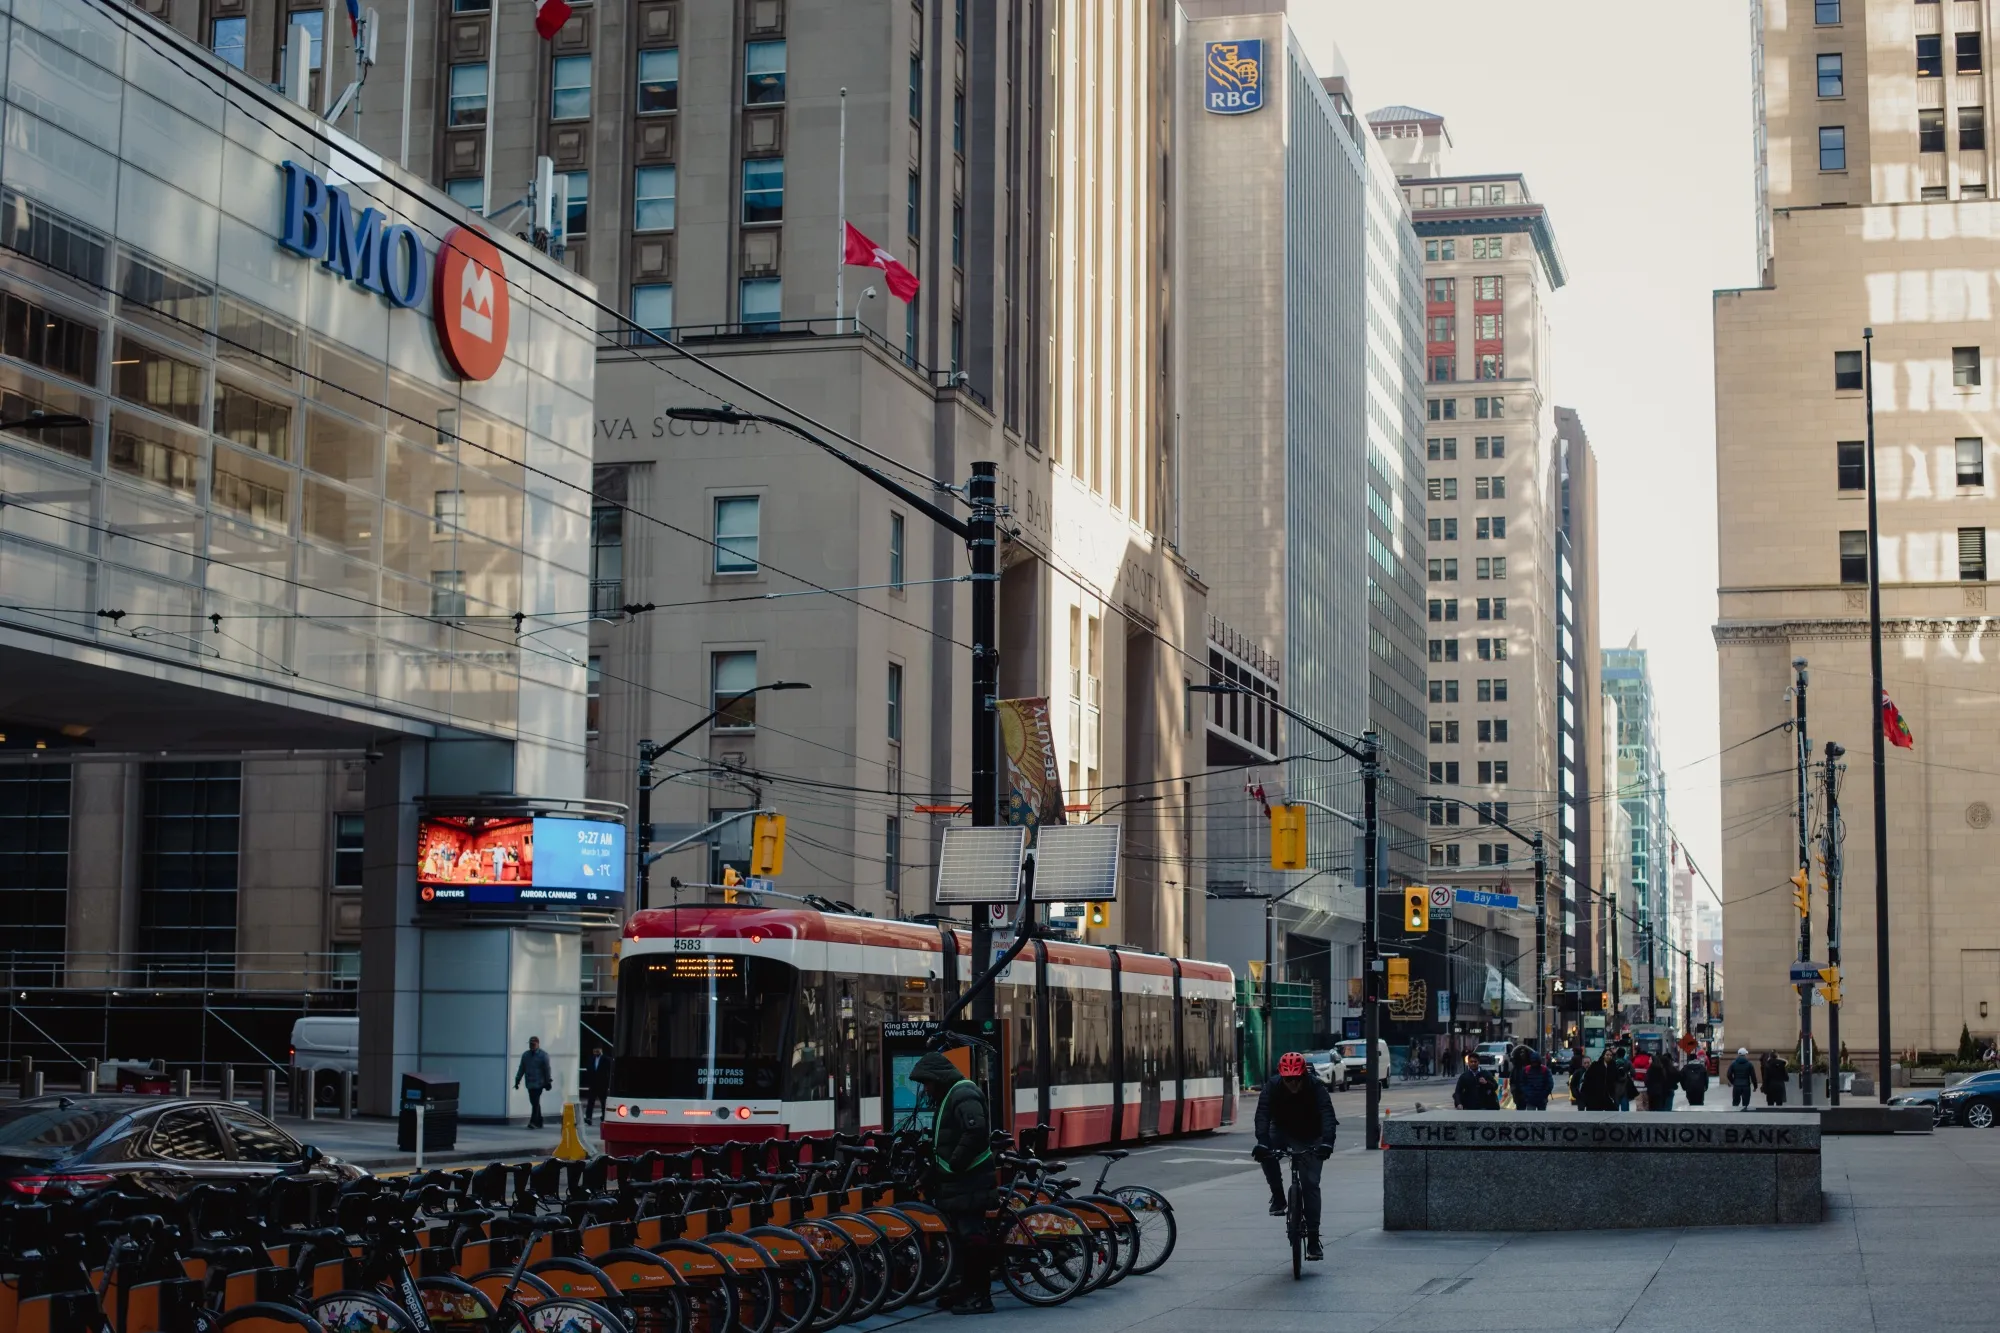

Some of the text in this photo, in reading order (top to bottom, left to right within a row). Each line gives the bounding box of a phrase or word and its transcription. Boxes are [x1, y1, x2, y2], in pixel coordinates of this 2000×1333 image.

[1210, 90, 1256, 108] RBC
[278, 160, 427, 308] BMO
[1126, 558, 1164, 610] SCOTIA
[577, 830, 613, 845] 9:27 AM
[520, 890, 577, 900] AURORA CANNABIS
[1473, 892, 1492, 904] Bay
[1000, 931, 1008, 940] NO
[674, 940, 701, 951] 4583
[1801, 971, 1812, 979] Bay
[884, 1022, 900, 1030] King
[925, 1021, 939, 1029] Bay
[884, 1029, 925, 1037] (West Side)
[697, 1068, 708, 1076] DO
[725, 1068, 744, 1076] PASS
[697, 1077, 744, 1085] OPEN DOORS
[1411, 1125, 1792, 1144] THE TORONTO-DOMINION BANK
[401, 1279, 425, 1328] Tangerine
